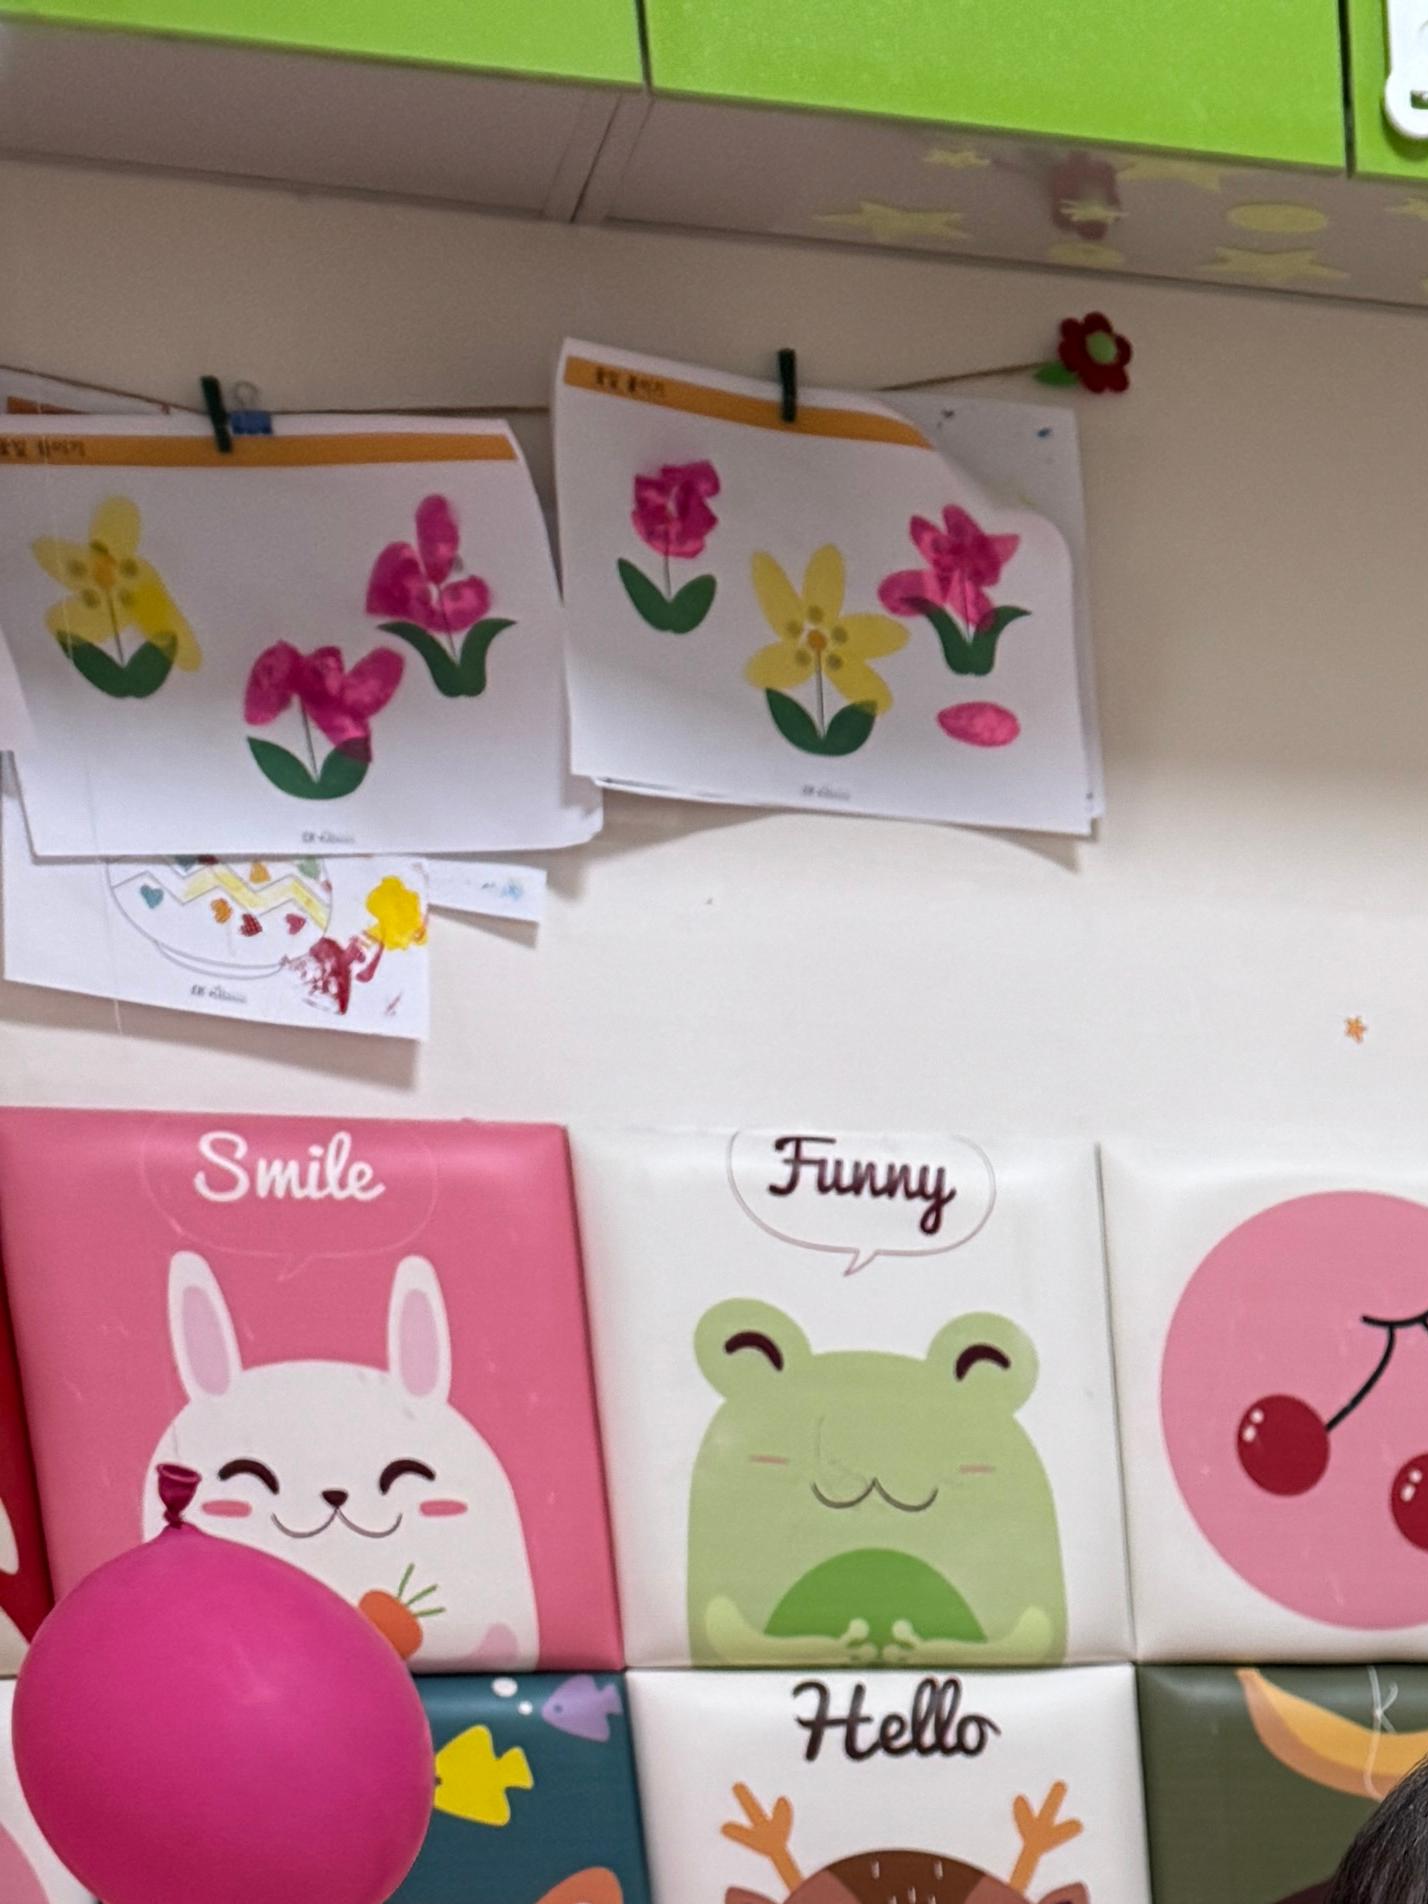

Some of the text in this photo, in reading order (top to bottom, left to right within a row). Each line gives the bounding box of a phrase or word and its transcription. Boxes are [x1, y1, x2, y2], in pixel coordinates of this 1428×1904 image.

[193, 1130, 386, 1205] Smile
[767, 1136, 956, 1236] Funny
[792, 1677, 1001, 1763] Hello
